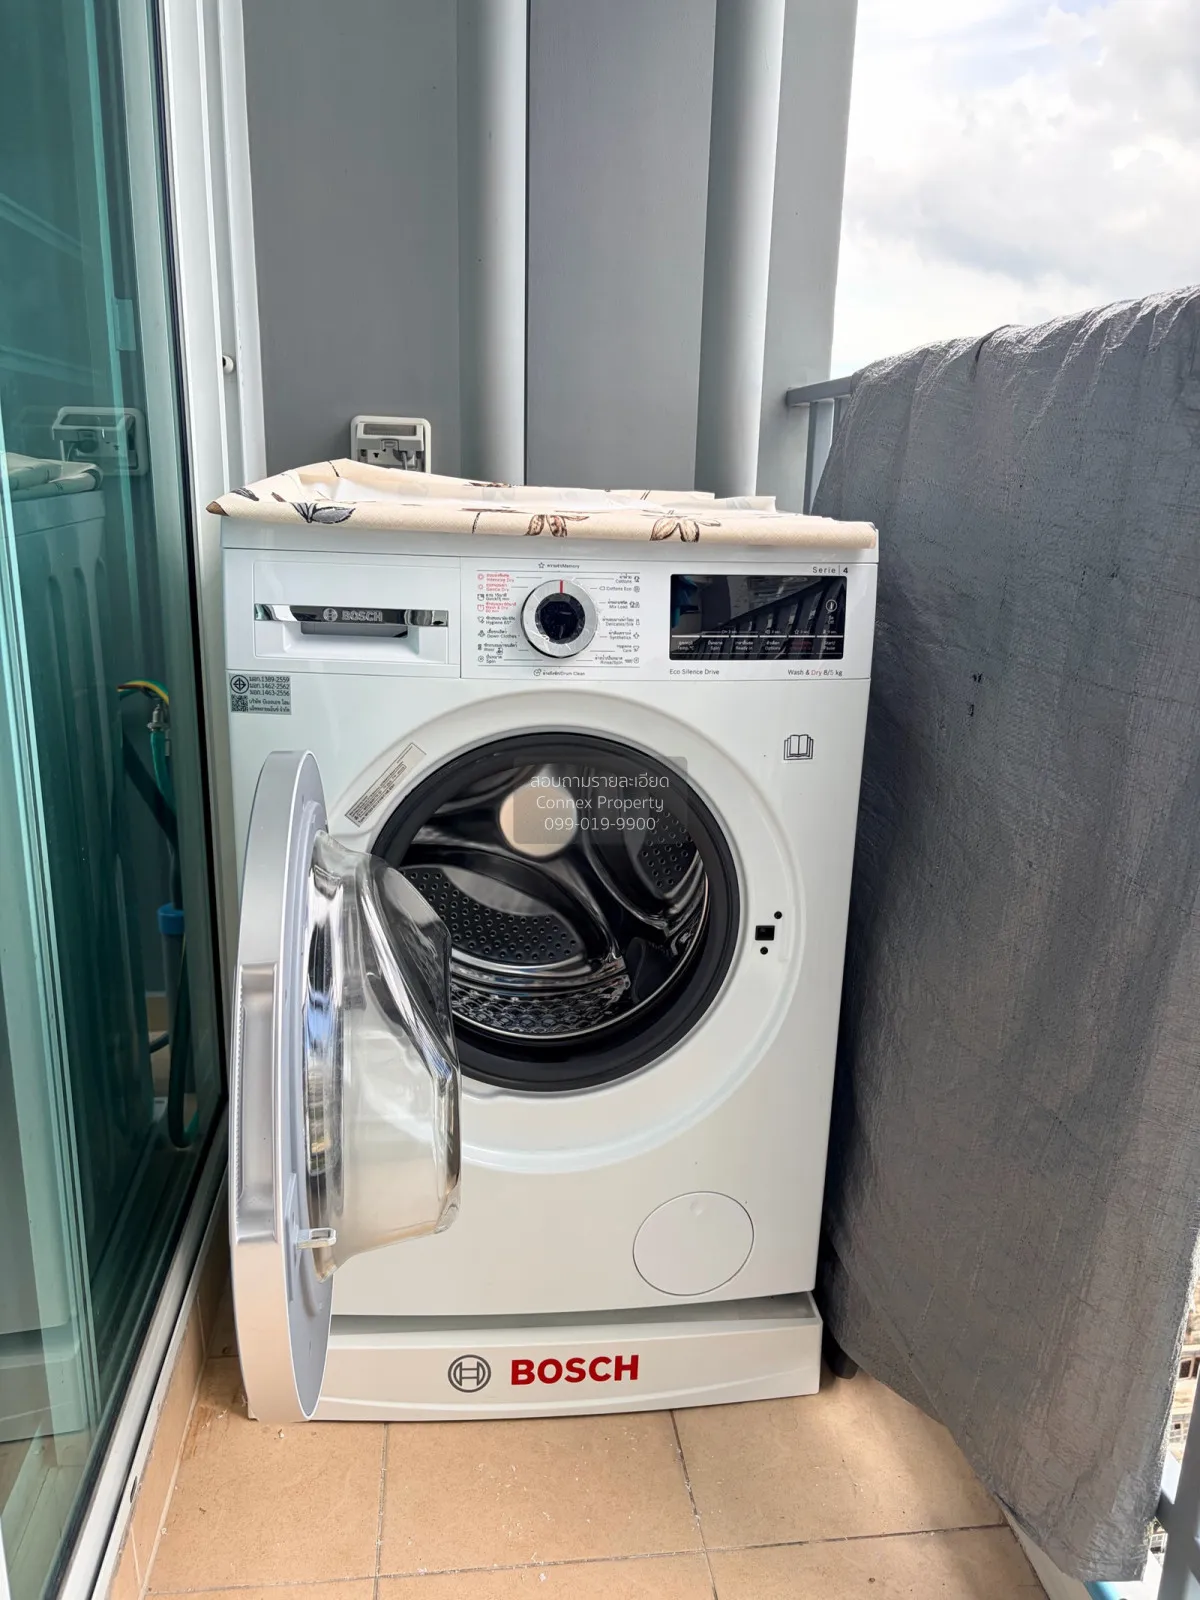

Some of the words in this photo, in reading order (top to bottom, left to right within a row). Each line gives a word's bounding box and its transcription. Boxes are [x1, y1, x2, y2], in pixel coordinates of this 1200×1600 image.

[812, 566, 836, 574] Serie
[341, 610, 383, 622] BOSCH
[811, 669, 822, 677] Dry
[835, 669, 843, 677] kg
[511, 1355, 639, 1385] BOSCH
